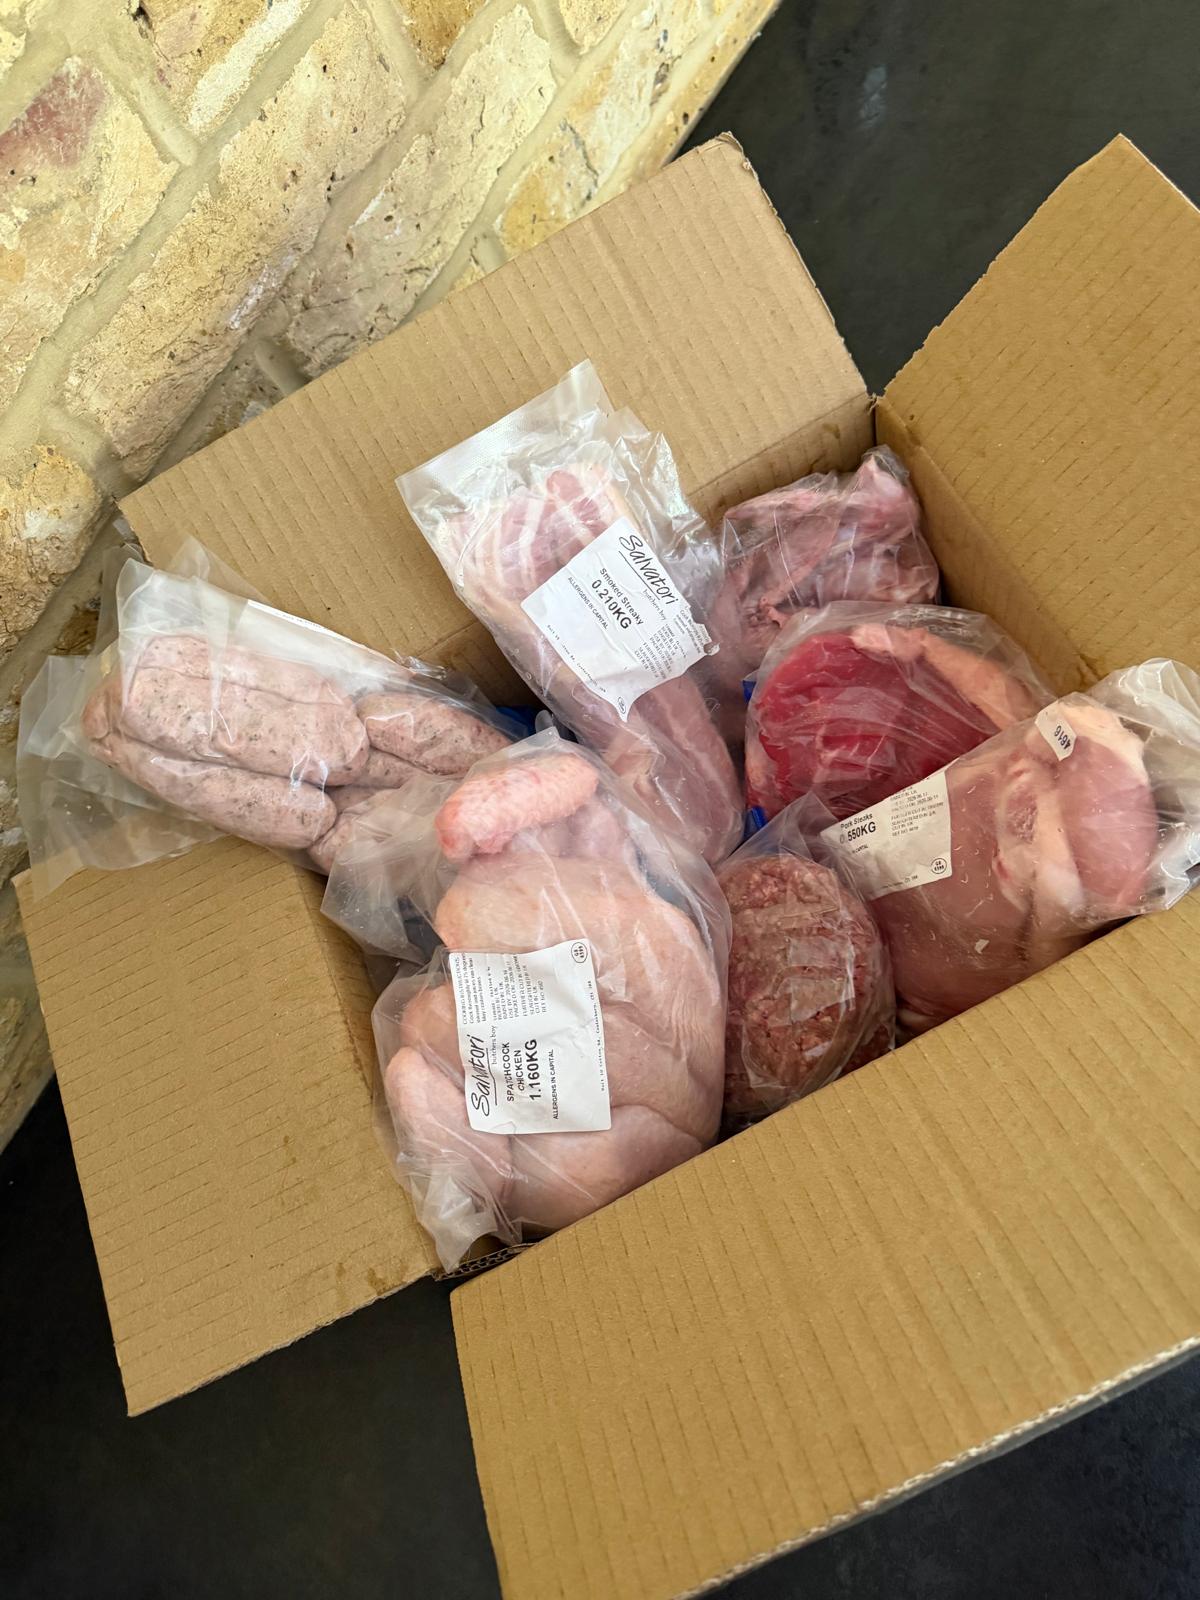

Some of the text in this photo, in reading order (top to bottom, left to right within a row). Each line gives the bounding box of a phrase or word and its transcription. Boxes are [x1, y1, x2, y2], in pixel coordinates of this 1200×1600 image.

[600, 568, 644, 625] Smoked Streaky
[618, 534, 679, 605] Salvatori
[568, 576, 592, 605] ALLERGENS
[592, 608, 609, 630] CAPITAL
[591, 579, 632, 630] 0.210KG
[1054, 725, 1071, 750] 4616
[840, 813, 873, 830] Pork Steaks
[490, 1025, 498, 1038] boy
[466, 1034, 490, 1116] Salvatori
[502, 1042, 514, 1102] SPATCHCOCK
[514, 1050, 525, 1092] CHICKEN
[525, 1039, 541, 1100] 1.160KG
